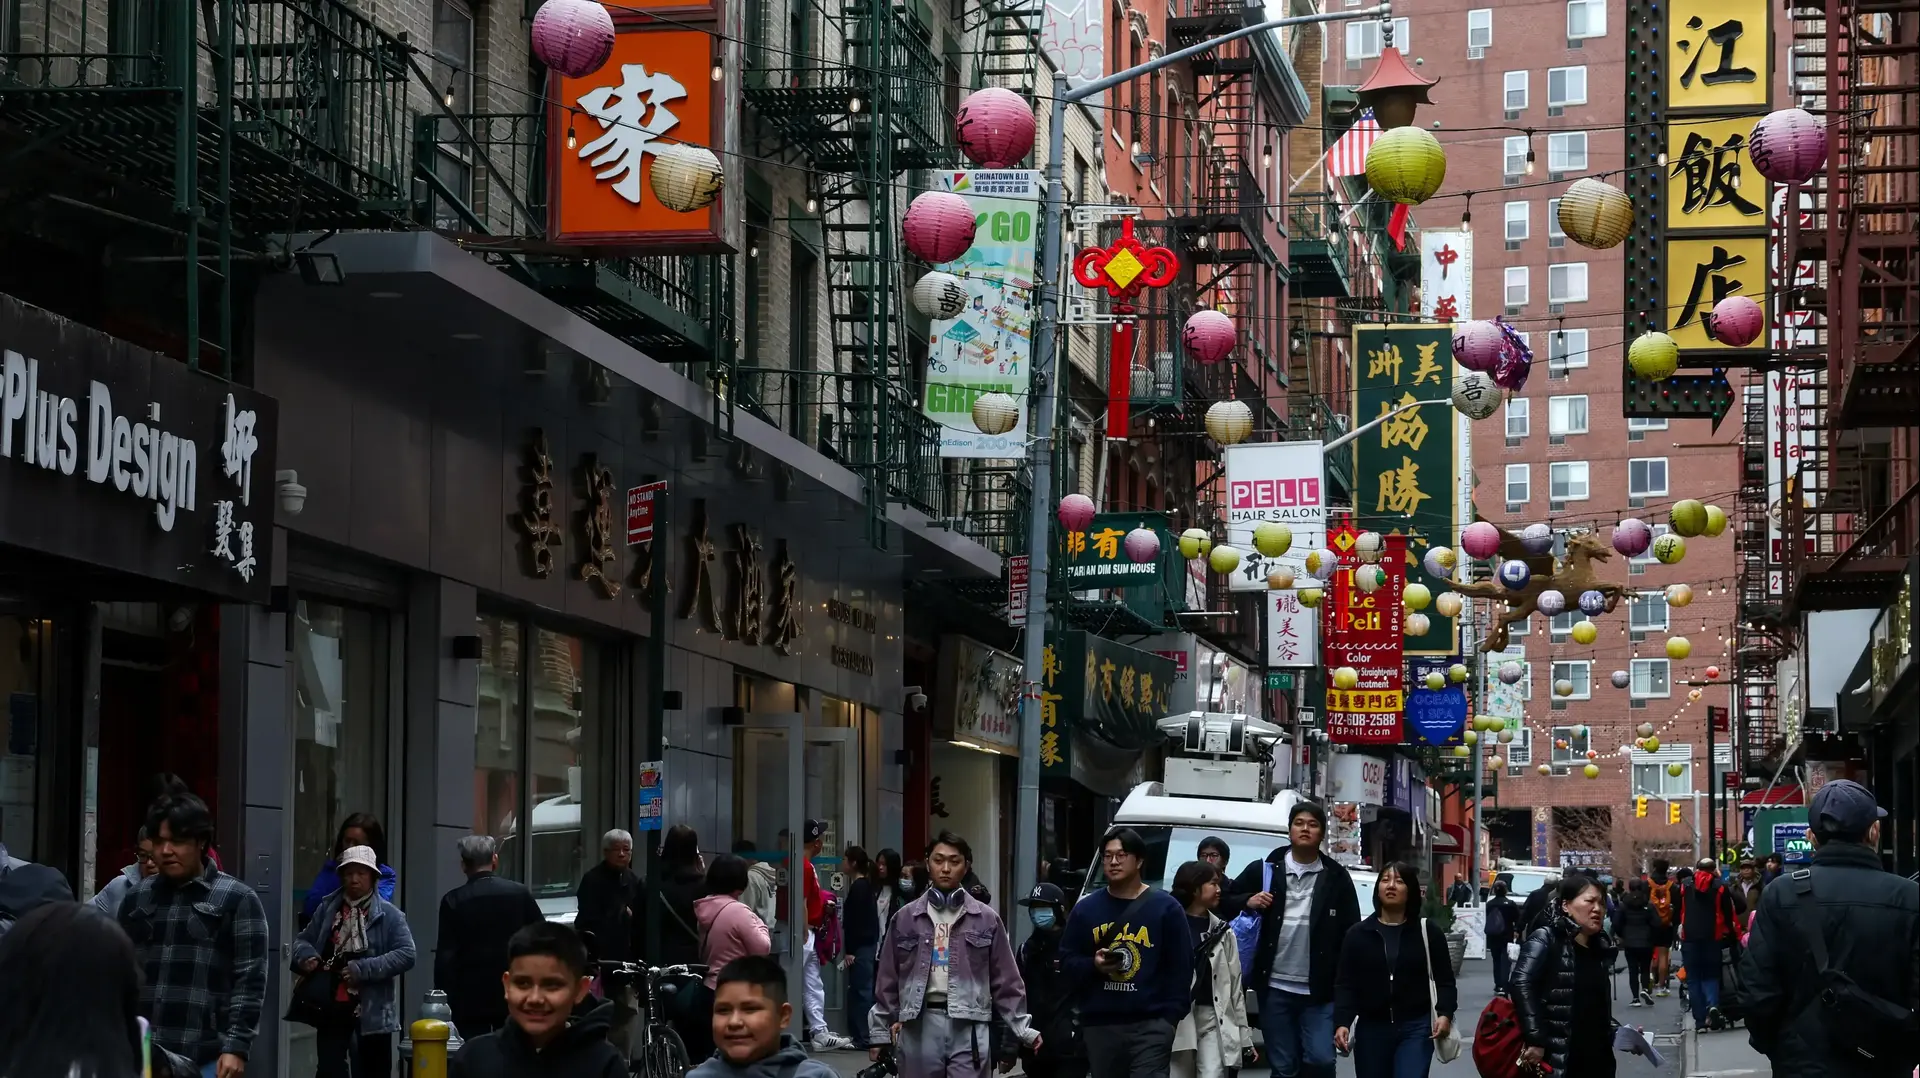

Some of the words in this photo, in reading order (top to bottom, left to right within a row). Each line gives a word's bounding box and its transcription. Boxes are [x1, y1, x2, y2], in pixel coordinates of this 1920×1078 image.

[576, 63, 688, 204] 家
[974, 172, 1014, 181] CHINATOWN
[991, 211, 1031, 242] GO
[86, 379, 197, 532] Design
[1232, 480, 1317, 506] PELL
[1231, 510, 1266, 520] HAIR
[1272, 507, 1321, 519] SALON
[1097, 563, 1111, 575] DIM
[1112, 563, 1128, 574] SUM
[1129, 562, 1156, 574] HOUSE
[1347, 590, 1376, 608] Le
[1391, 574, 1399, 637] 18Pell.com
[1276, 595, 1299, 661] 瓏美容
[1346, 651, 1372, 663] Color
[1415, 694, 1461, 706] OCEAN
[1328, 712, 1396, 727] 212-608-2588
[1427, 708, 1455, 720] SPA
[1330, 726, 1391, 736] 18Pell.com
[1786, 840, 1812, 851] ATM
